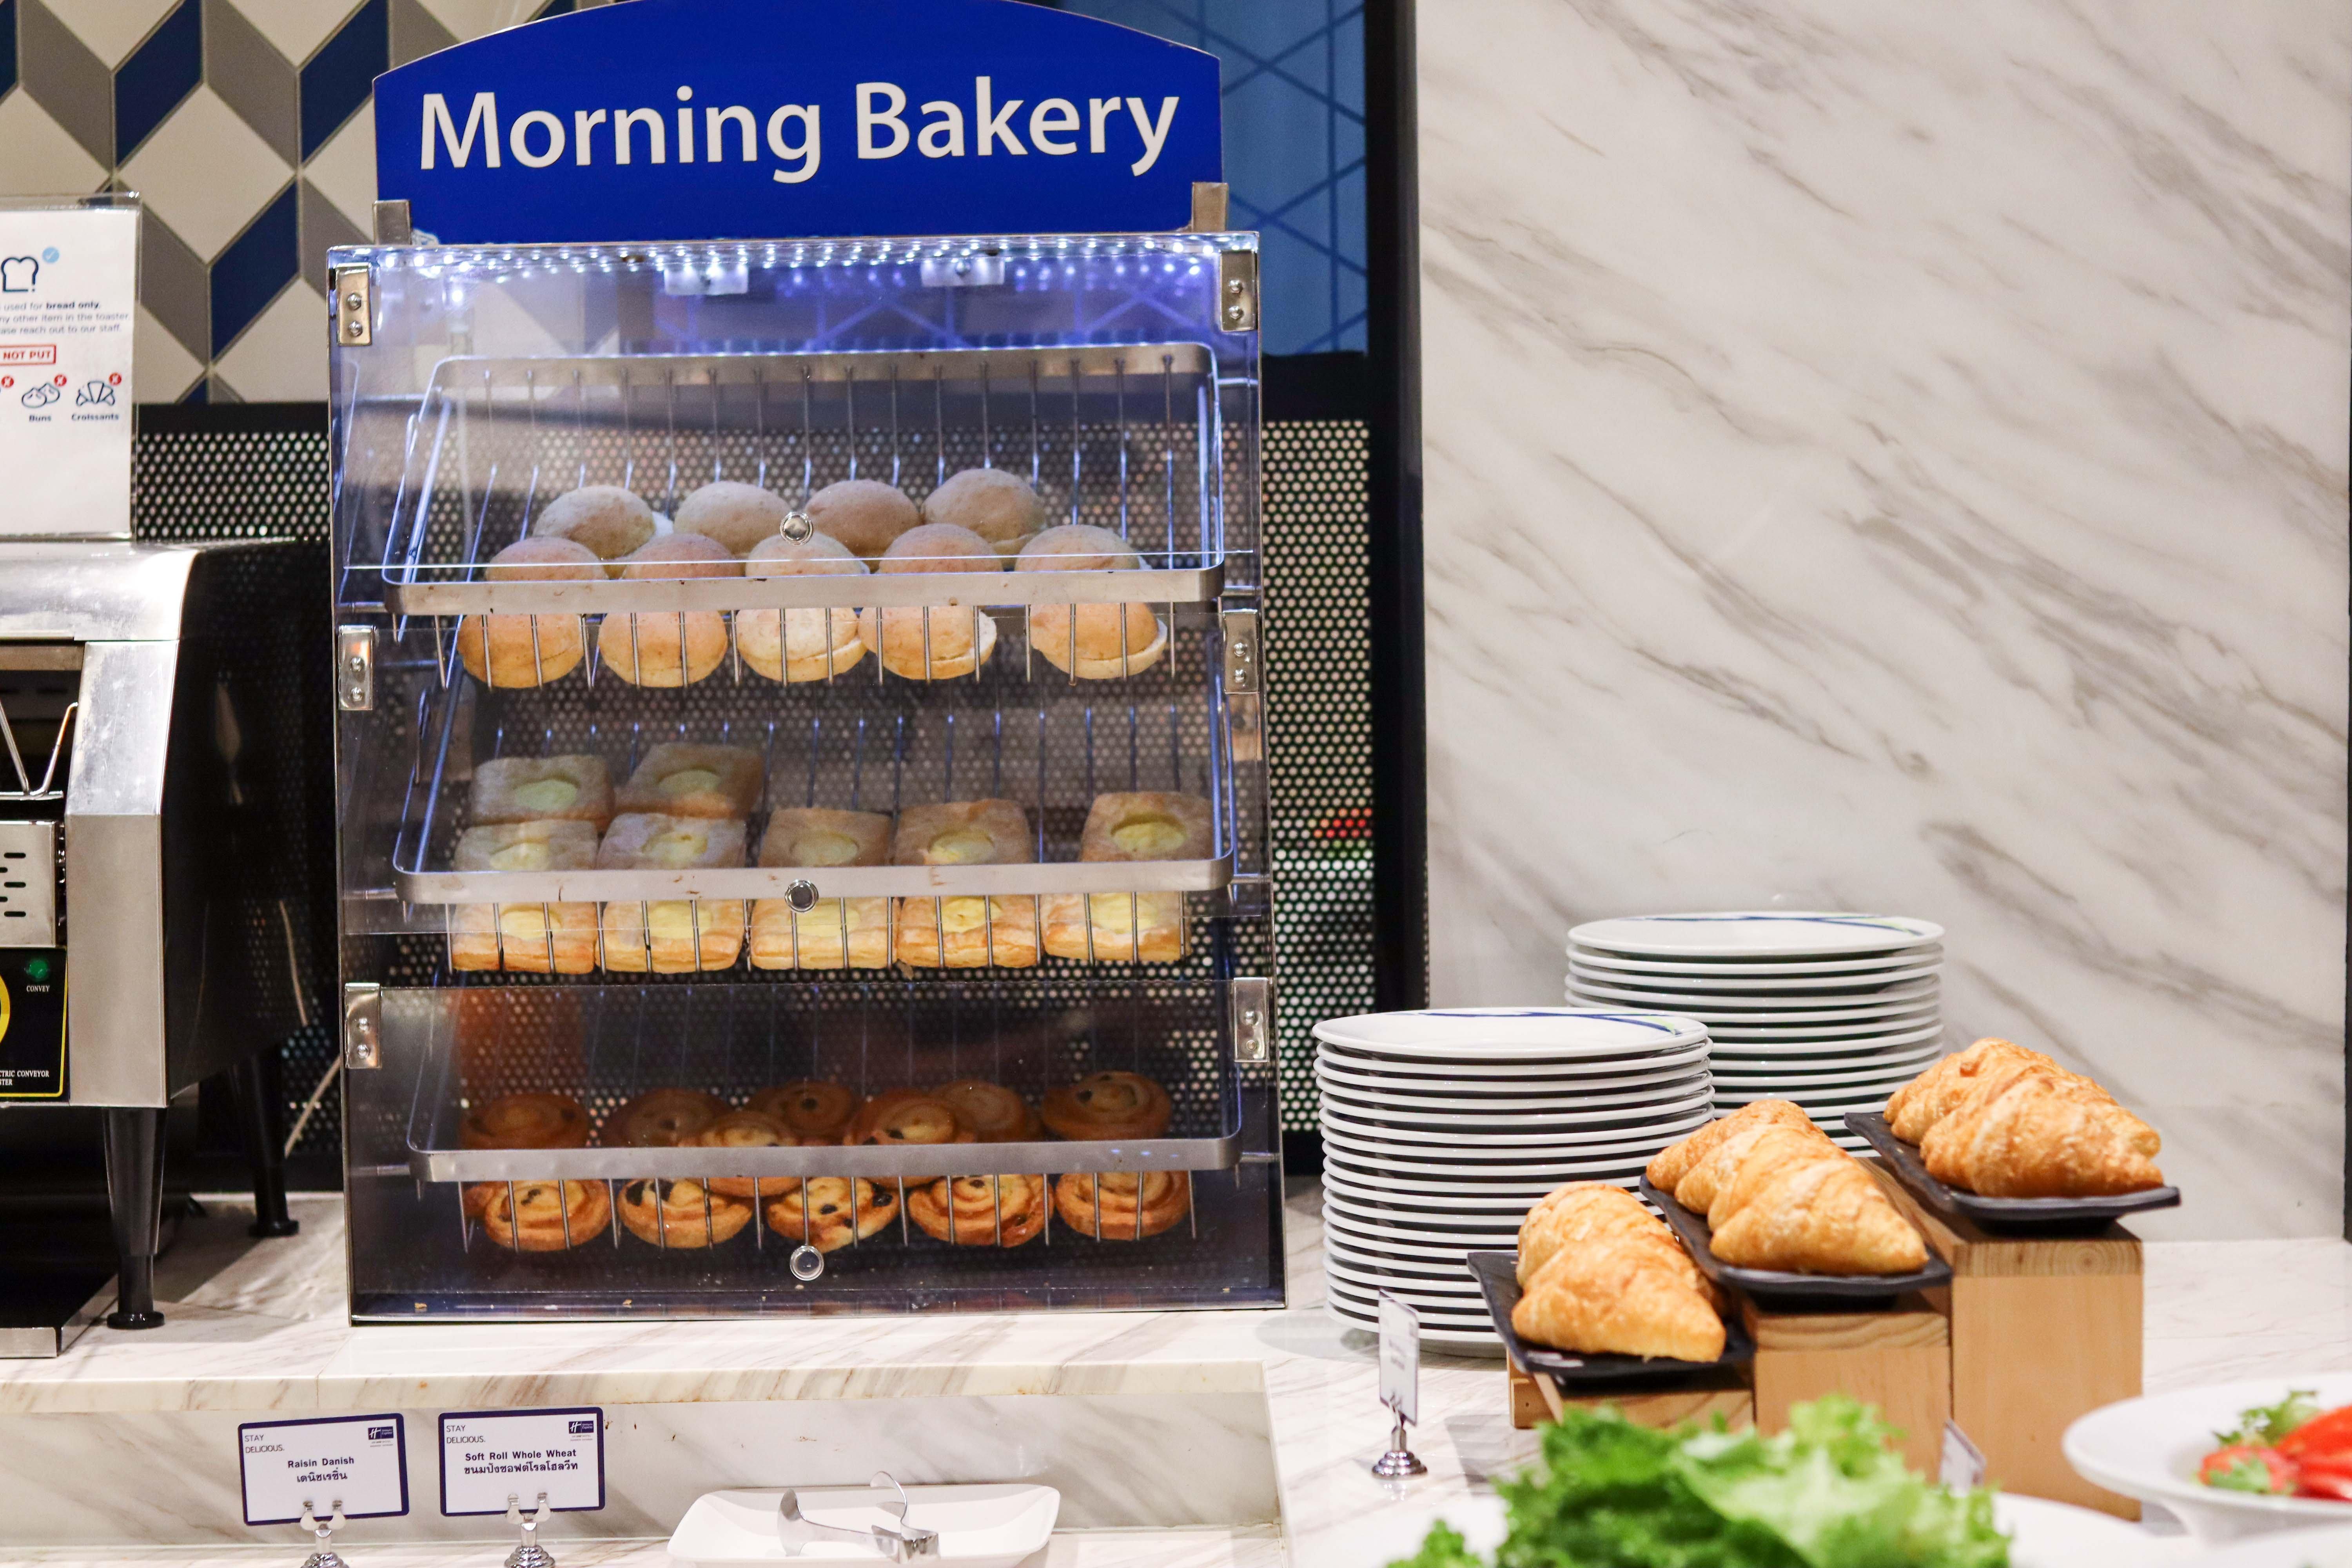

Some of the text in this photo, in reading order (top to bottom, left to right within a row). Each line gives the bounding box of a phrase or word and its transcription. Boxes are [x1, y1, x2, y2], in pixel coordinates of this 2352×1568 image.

[421, 76, 1179, 183] Morning Bakery
[30, 302, 42, 310] for
[3, 350, 51, 359] NOT PUT
[244, 1434, 264, 1442] STAY
[446, 1436, 486, 1444] DELICIOUS.
[245, 1445, 285, 1454] DELICIOUS.
[465, 1449, 577, 1461] Soft Roll Whole Wheat
[287, 1456, 354, 1468] Raisin Danish
